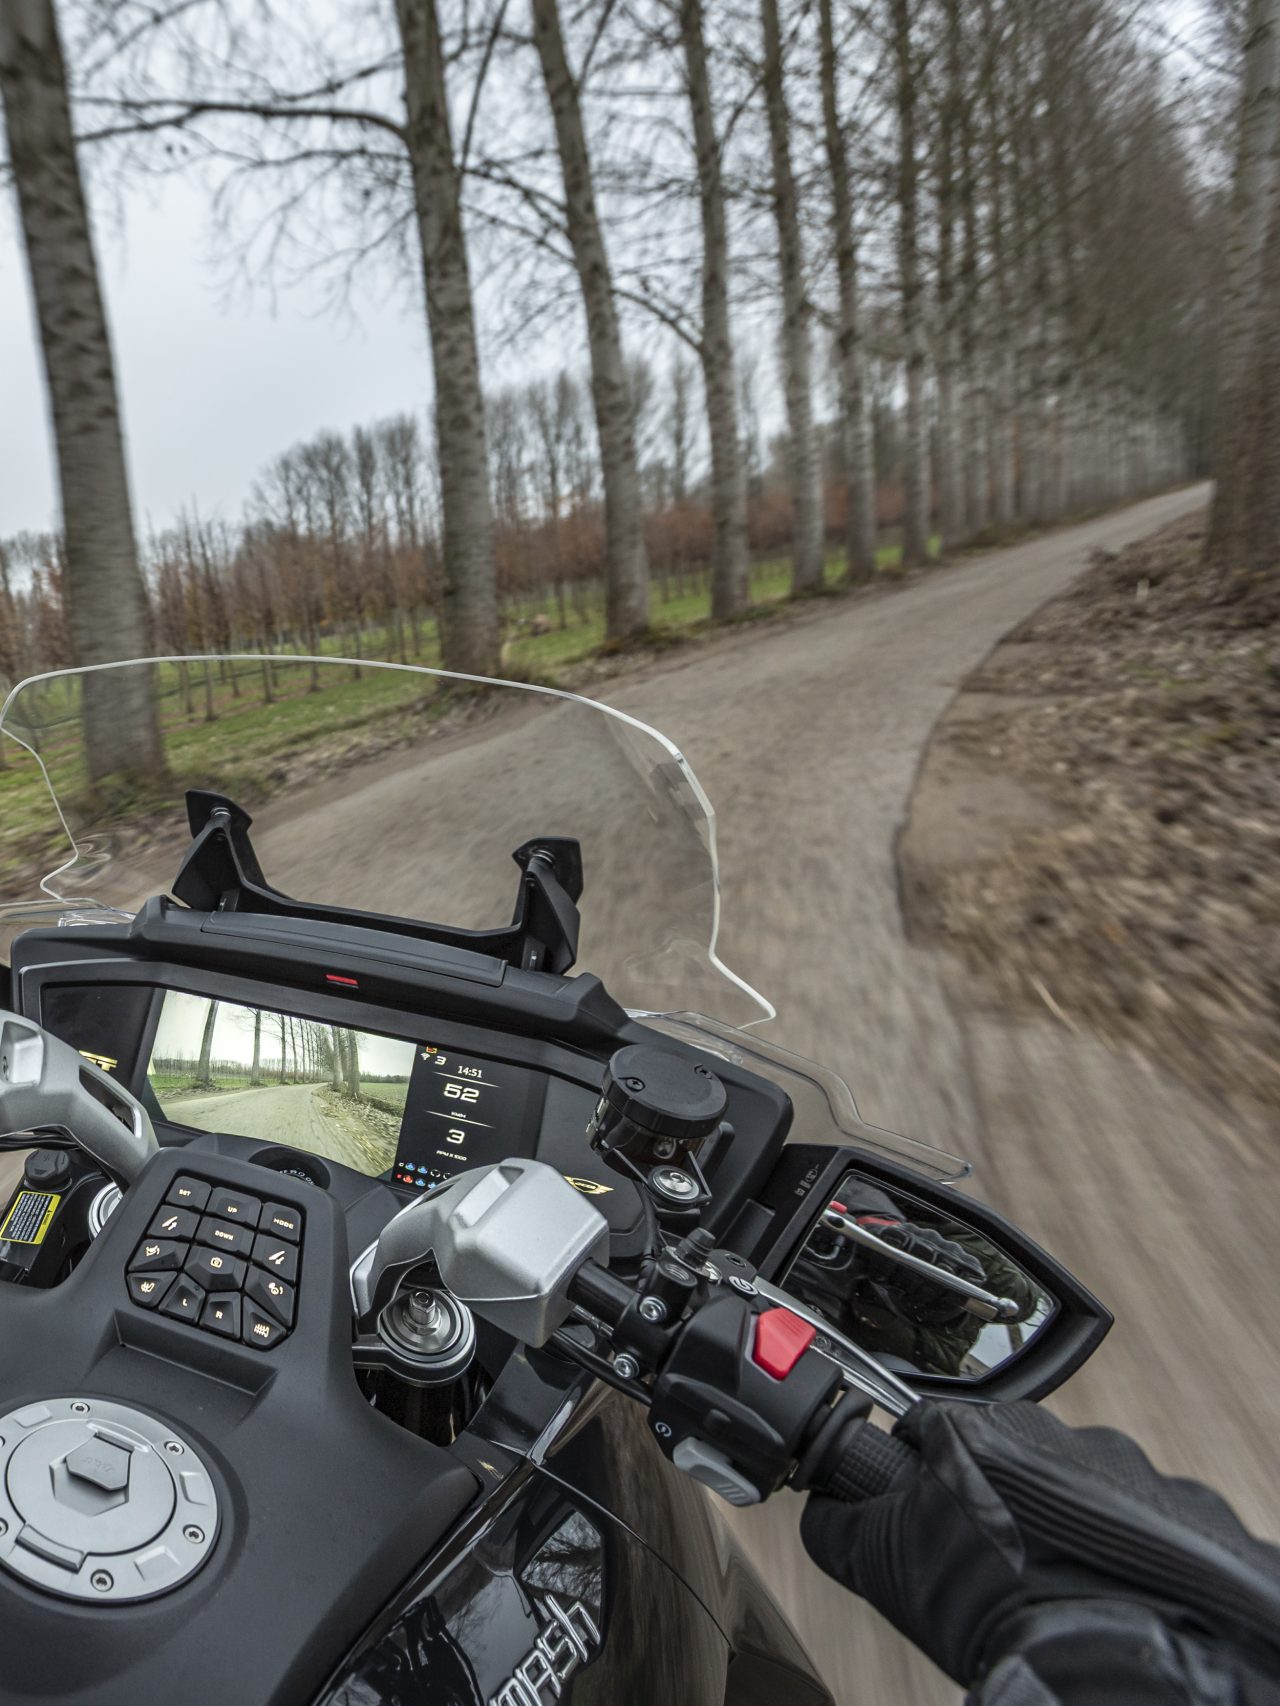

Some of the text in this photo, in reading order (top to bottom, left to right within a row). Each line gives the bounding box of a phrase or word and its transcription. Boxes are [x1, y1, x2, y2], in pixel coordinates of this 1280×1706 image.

[435, 1055, 447, 1066] 3
[457, 1065, 483, 1078] 14:51
[443, 1082, 480, 1103] 52
[446, 1128, 465, 1144] 3
[178, 1188, 192, 1197] SET
[227, 1206, 238, 1214] UP
[273, 1217, 294, 1230] MODE
[214, 1229, 234, 1241] DOWN
[182, 1298, 188, 1307] L
[215, 1310, 223, 1320] R
